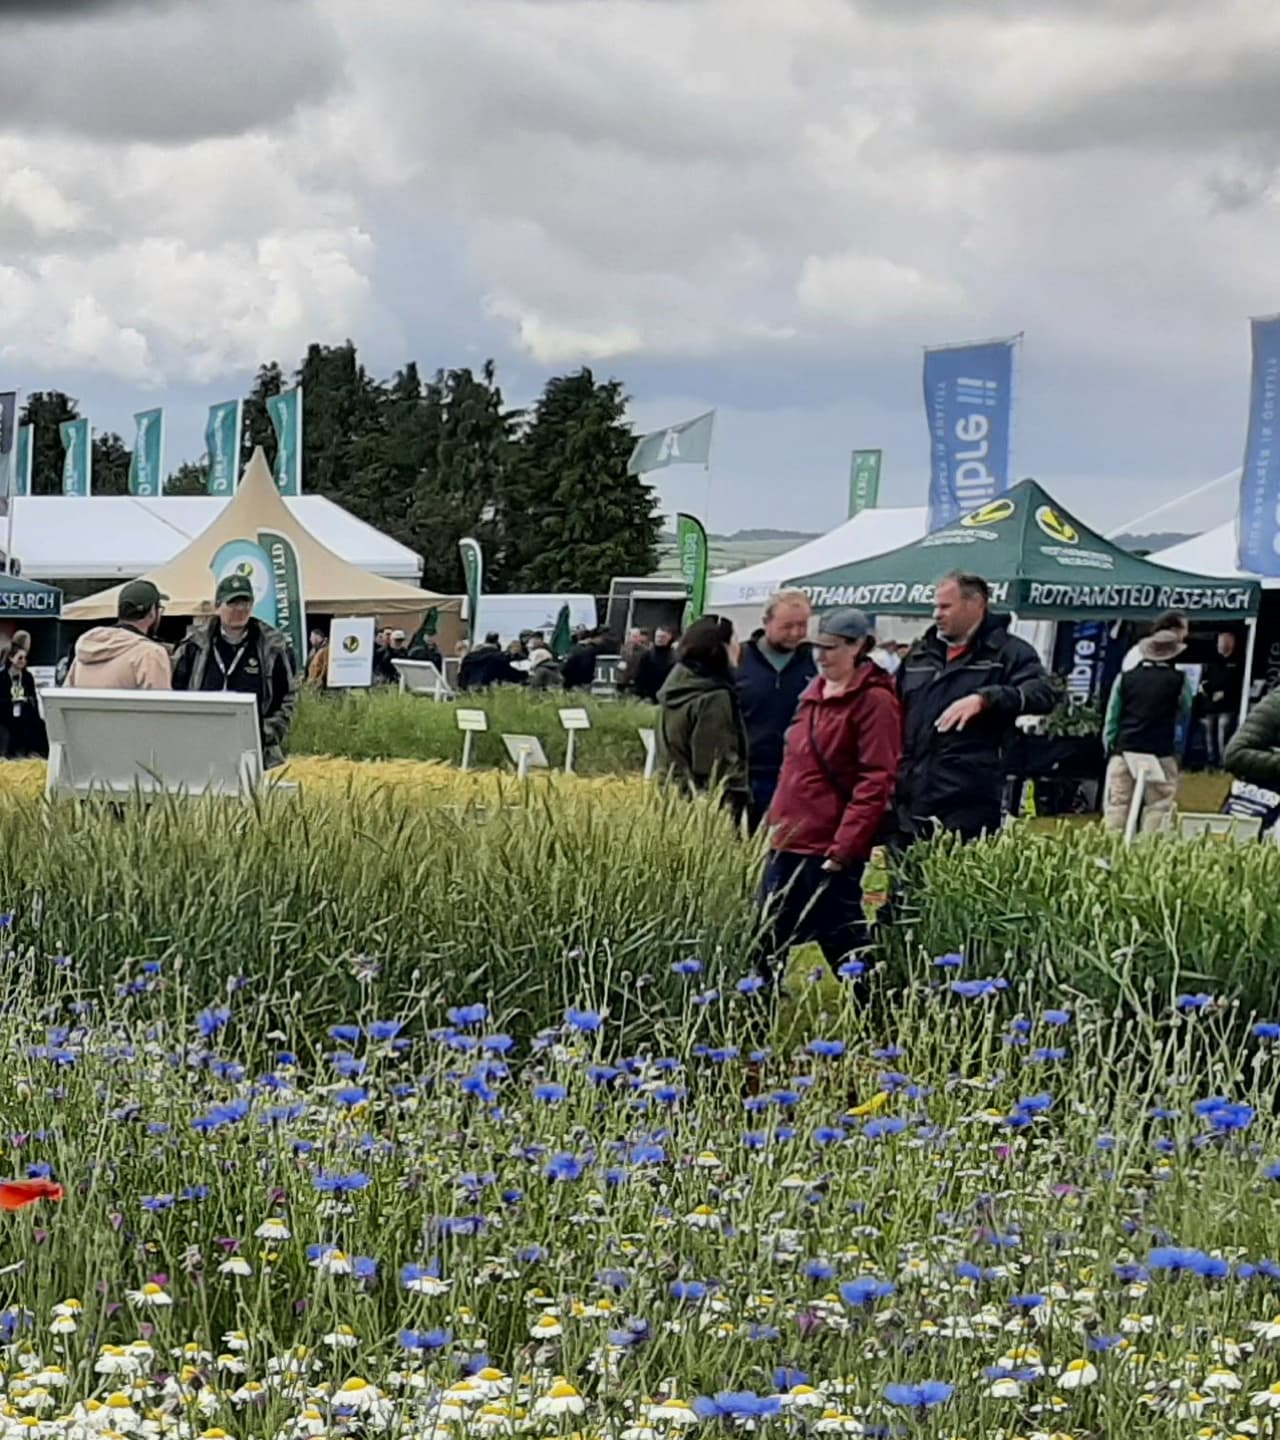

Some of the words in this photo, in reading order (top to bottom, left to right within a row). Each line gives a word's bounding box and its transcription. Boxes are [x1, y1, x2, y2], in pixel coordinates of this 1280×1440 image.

[801, 583, 906, 606] THAMSTED
[1028, 582, 1155, 606] ROTHAMSTED
[1157, 586, 1251, 609] RESEARCH
